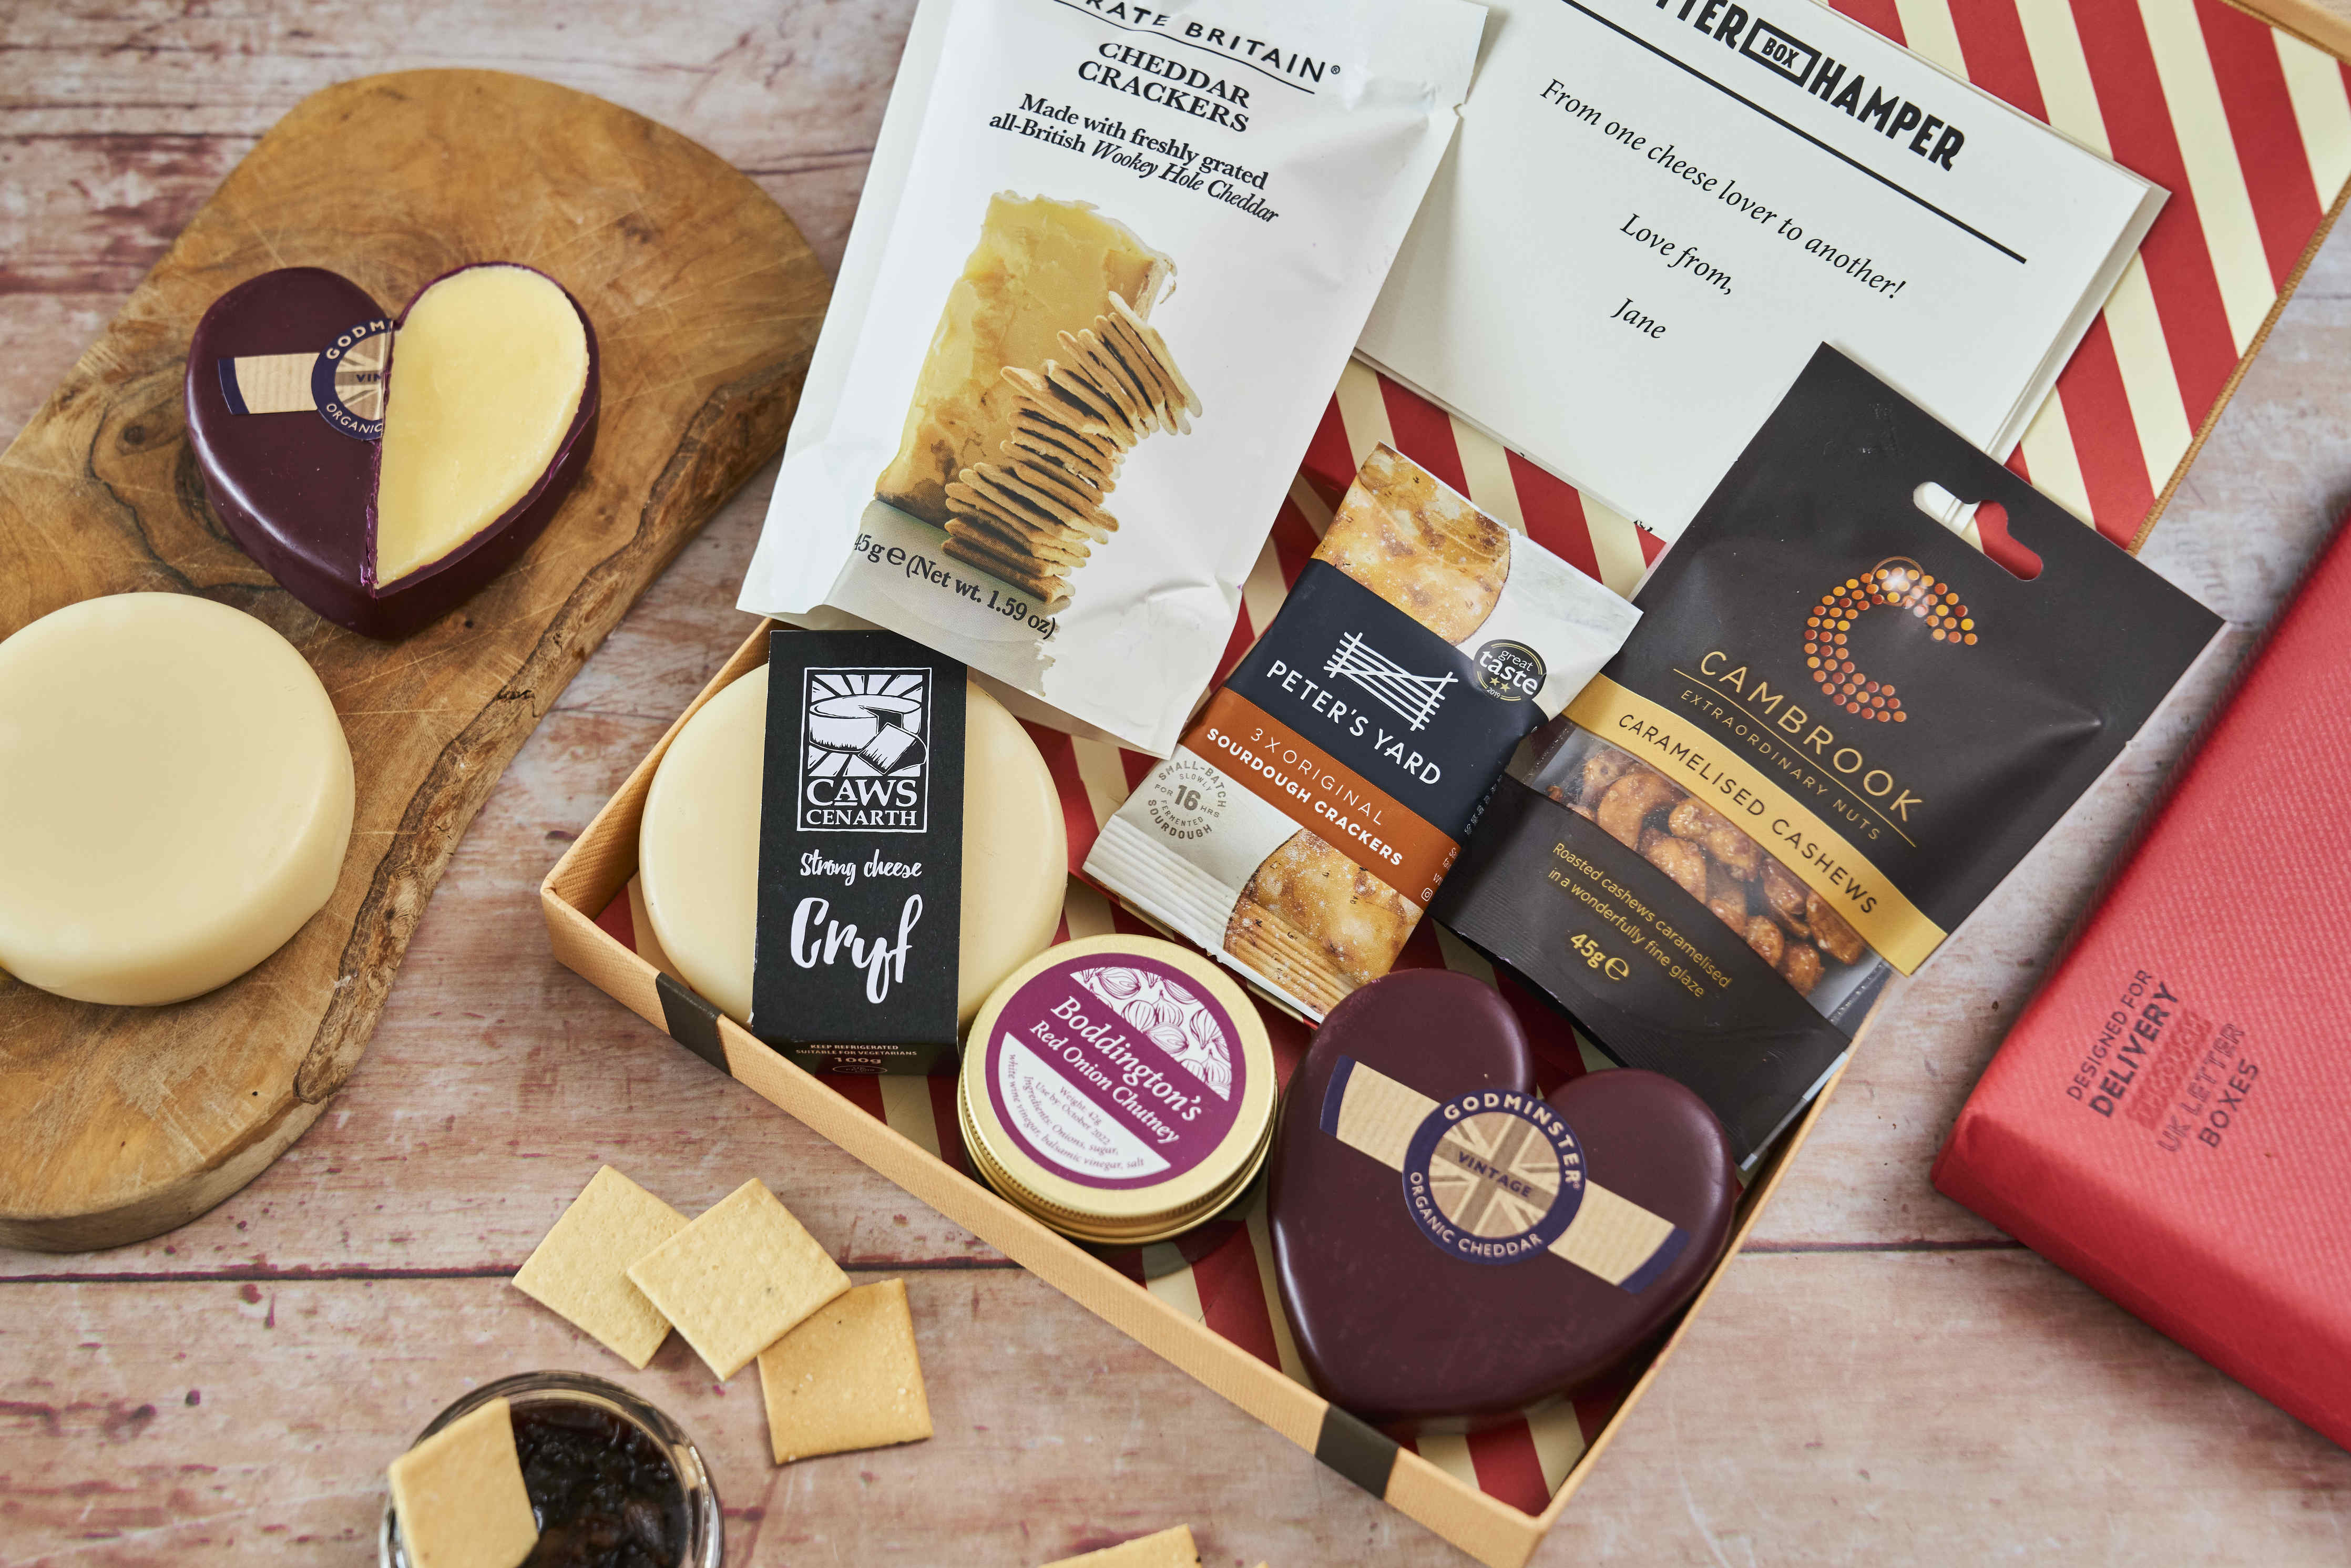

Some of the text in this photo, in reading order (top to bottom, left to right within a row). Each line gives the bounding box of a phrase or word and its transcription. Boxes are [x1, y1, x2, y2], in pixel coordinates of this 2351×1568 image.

[1078, 60, 1250, 133] CRACKERS
[1098, 43, 1251, 109] CHEDDAR
[1761, 36, 1800, 69] BOX
[1807, 56, 1965, 172] HAMPER
[988, 112, 1280, 223] all-British Wookey Hole Cheddar
[1018, 93, 1269, 191] Made with freshly grated
[1540, 79, 1907, 299] From one cheese lover to another!
[1620, 213, 1734, 295] Love from,
[1610, 298, 1667, 339] Jane
[326, 403, 384, 434] ORGANIC
[906, 554, 952, 588] (Net
[955, 578, 982, 603] wt.
[987, 590, 1028, 621] 1.59
[1027, 614, 1056, 640] oz)
[1479, 651, 1538, 695] taste
[1486, 687, 1501, 699] 2019
[1498, 650, 1534, 671] great
[1266, 659, 1442, 785] PETER'S YARD
[1700, 650, 1923, 823] CAMBROOK
[806, 778, 917, 807] CAWS
[1154, 783, 1220, 818] FOR 16 HRS
[1158, 760, 1227, 807] SMALL-BATCH
[1179, 773, 1212, 792] SLOWLY
[1207, 727, 1312, 803] SOURDOUGH
[1314, 800, 1404, 866] CRACKERS
[1282, 750, 1383, 826] ORIGINAL
[1680, 689, 1882, 841] EXTRAORDINARY NUTS
[805, 809, 917, 826] CENARTH
[1148, 799, 1213, 839] SOURDOUGH
[1161, 800, 1203, 827] FERMENTED
[1618, 714, 1765, 816] CARAMELISED
[1771, 818, 1878, 915] CASHEWS
[863, 848, 922, 879] cheese
[790, 894, 923, 1005] Cryf
[1548, 867, 1705, 998] in a wonderfully fine glaze
[1552, 843, 1732, 988] Roasted cashews caramelised
[1050, 996, 1202, 1122] Boddington's
[2066, 969, 2153, 1101] DESIGNED FOR
[2088, 981, 2179, 1118] DELIVERY
[1029, 1020, 1180, 1144] Red Onion Chutney
[1061, 1103, 1091, 1130] October
[2157, 1023, 2245, 1153] UK LETTER
[2197, 1059, 2259, 1148] BOXES
[1126, 1157, 1144, 1169] salt
[1458, 1151, 1532, 1198] VINTAGE
[1409, 1171, 1543, 1258] ORGANIC CHEDDAR
